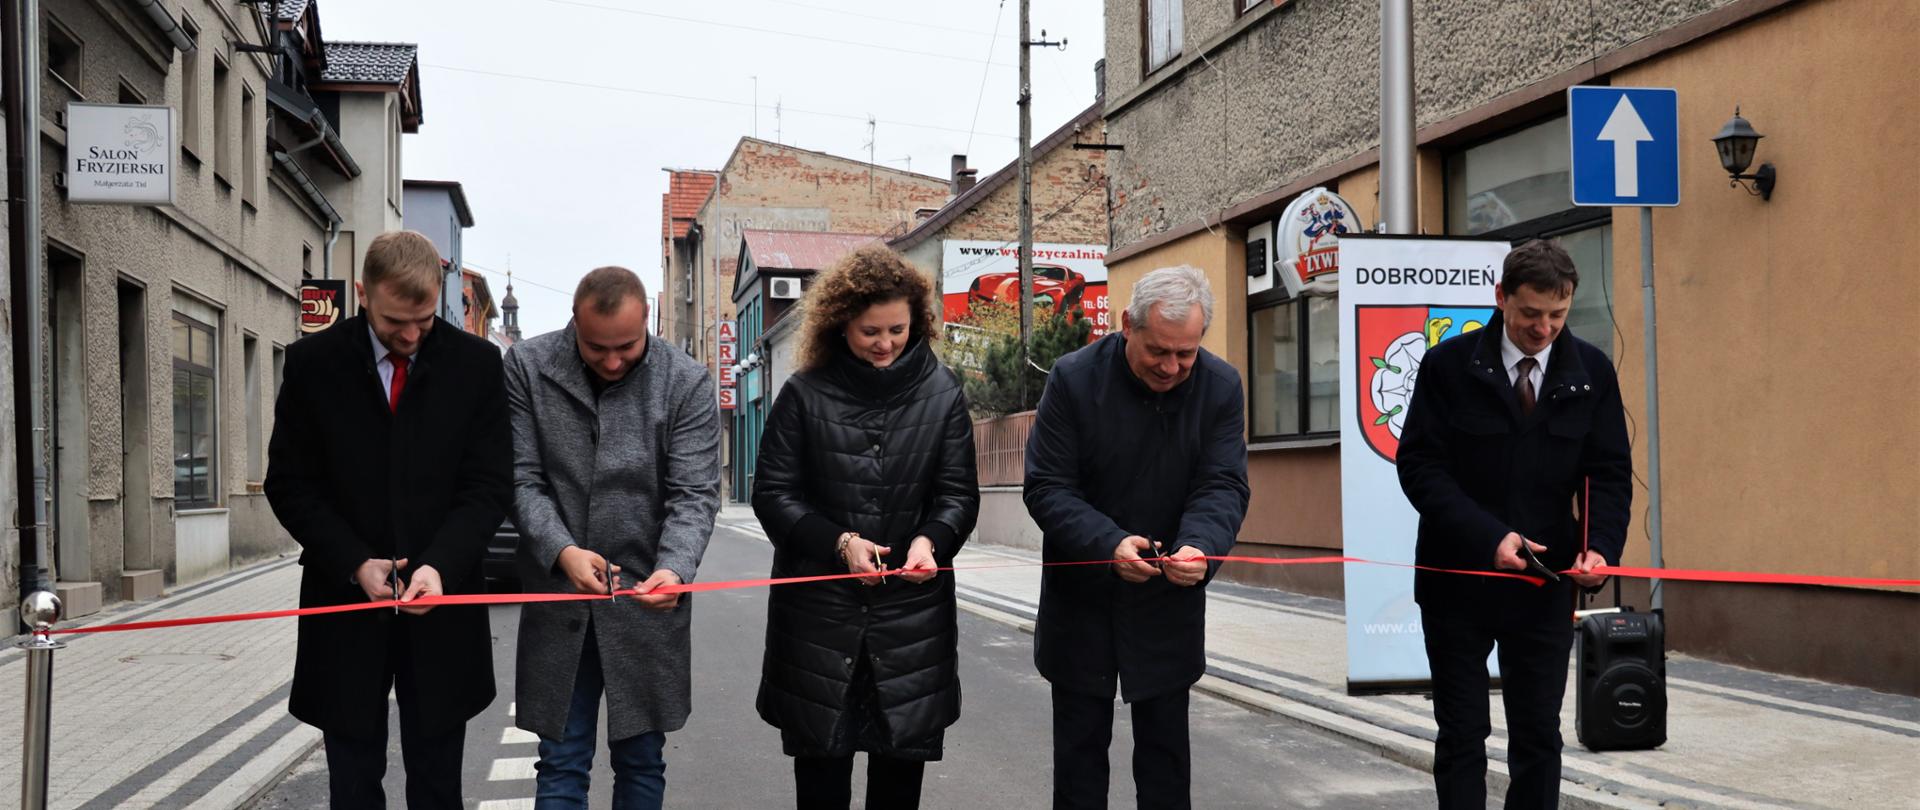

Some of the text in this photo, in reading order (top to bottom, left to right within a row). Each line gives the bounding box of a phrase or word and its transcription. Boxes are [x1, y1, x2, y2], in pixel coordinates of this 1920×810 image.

[89, 146, 138, 160] SALON
[77, 159, 164, 175] FRYZJERSKI
[1356, 265, 1495, 286] DOBRODZIEŃ
[303, 290, 336, 300] BUTY
